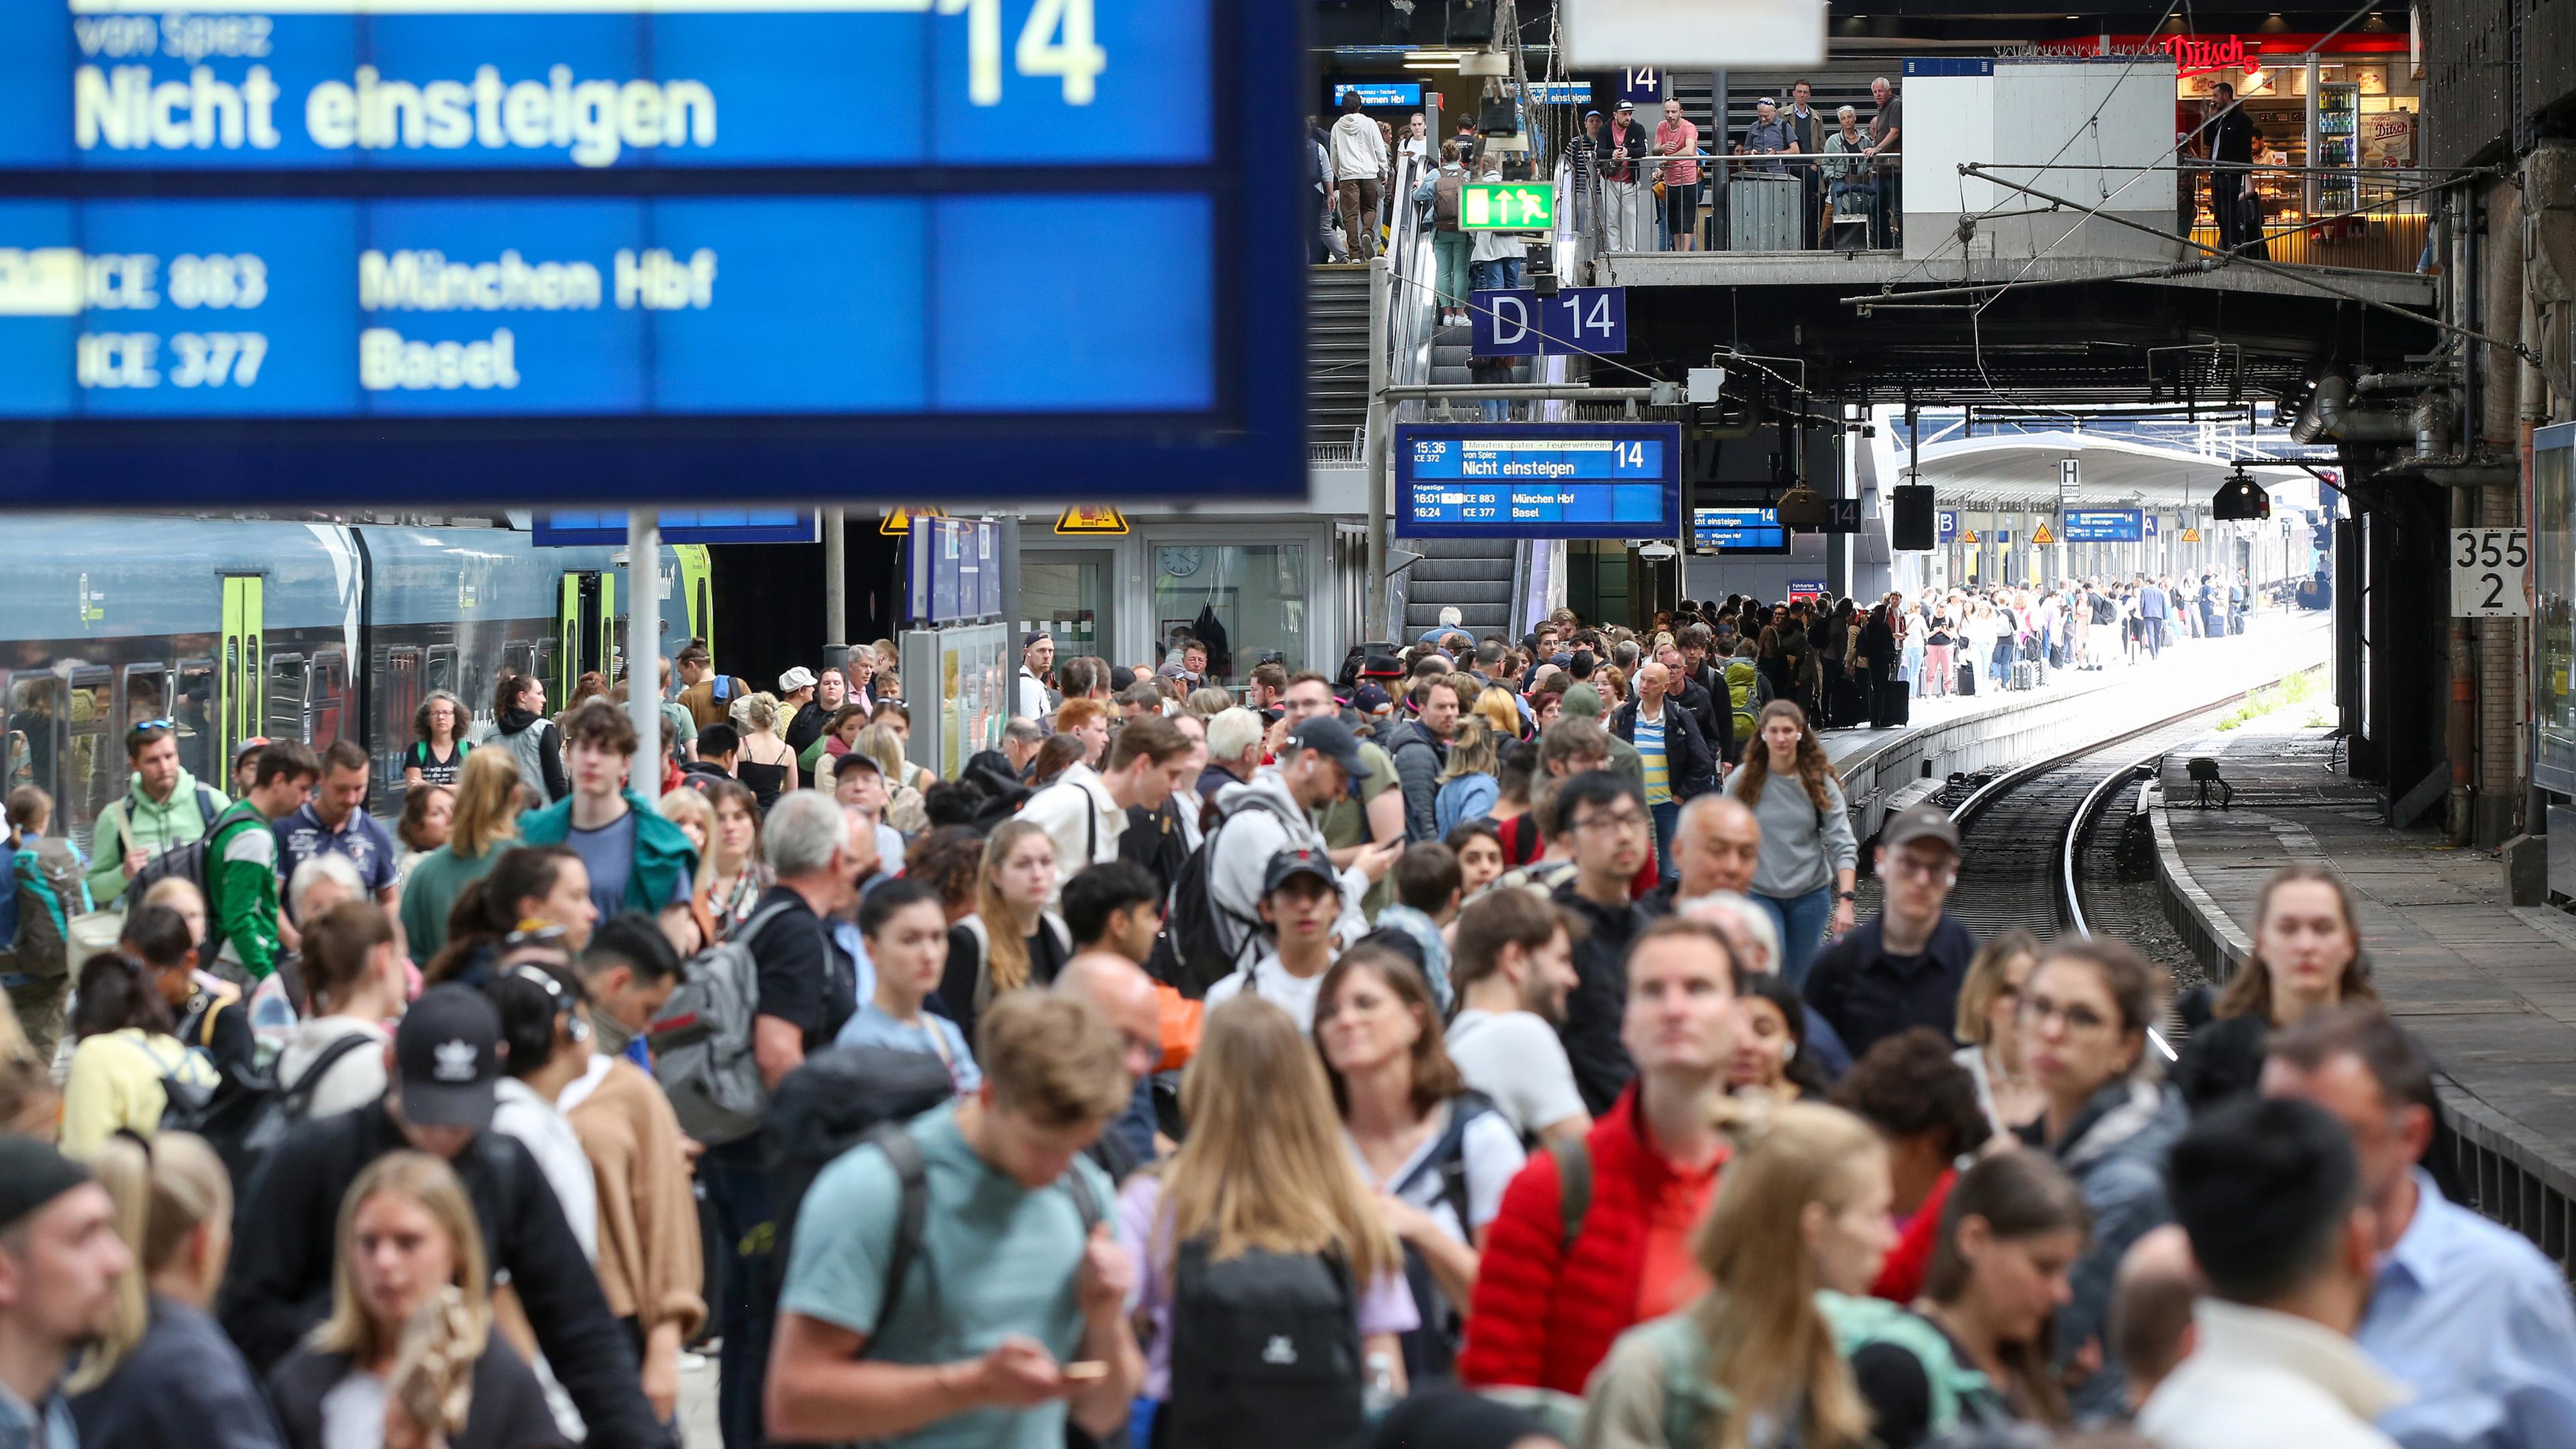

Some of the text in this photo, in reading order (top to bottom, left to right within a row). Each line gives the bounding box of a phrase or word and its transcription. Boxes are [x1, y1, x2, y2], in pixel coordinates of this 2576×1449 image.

[74, 15, 158, 58] von
[937, 0, 1106, 106] 14
[2165, 34, 2243, 70] Ditsch
[1619, 65, 1658, 92] 14
[1391, 95, 1405, 103] Hbf
[74, 64, 717, 168] Nicht einsteigen
[2375, 122, 2408, 137] Ditsch
[80, 253, 162, 310] ICE
[168, 253, 268, 310] 883
[358, 249, 602, 311] München
[613, 248, 718, 311] Hbf
[1493, 297, 1528, 345] D
[1563, 294, 1615, 339] 14
[76, 327, 521, 390] ICE 377 Basel
[1414, 441, 1446, 453] 15:36
[1469, 441, 1503, 449] Minuten
[1614, 441, 1644, 468] 14
[1478, 451, 1497, 460] Spiez
[1463, 461, 1574, 478] Nicht einsteigen
[2063, 462, 2077, 483] H
[1413, 494, 1440, 503] 16:01
[1463, 494, 1477, 504] ICE
[1479, 494, 1495, 503] 883
[1512, 494, 1554, 504] München
[1557, 494, 1575, 504] Hbf
[1413, 508, 1540, 517] 16:24 ICE 377 Basel
[1760, 508, 1774, 522] 14
[1829, 502, 1856, 525] 14
[1940, 513, 1953, 531] B
[2124, 513, 2133, 523] 14
[1707, 518, 1742, 527] einsteigen
[2145, 517, 2155, 533] A
[2282, 525, 2290, 537] H
[2457, 533, 2528, 568] 355
[2480, 573, 2503, 608] 2
